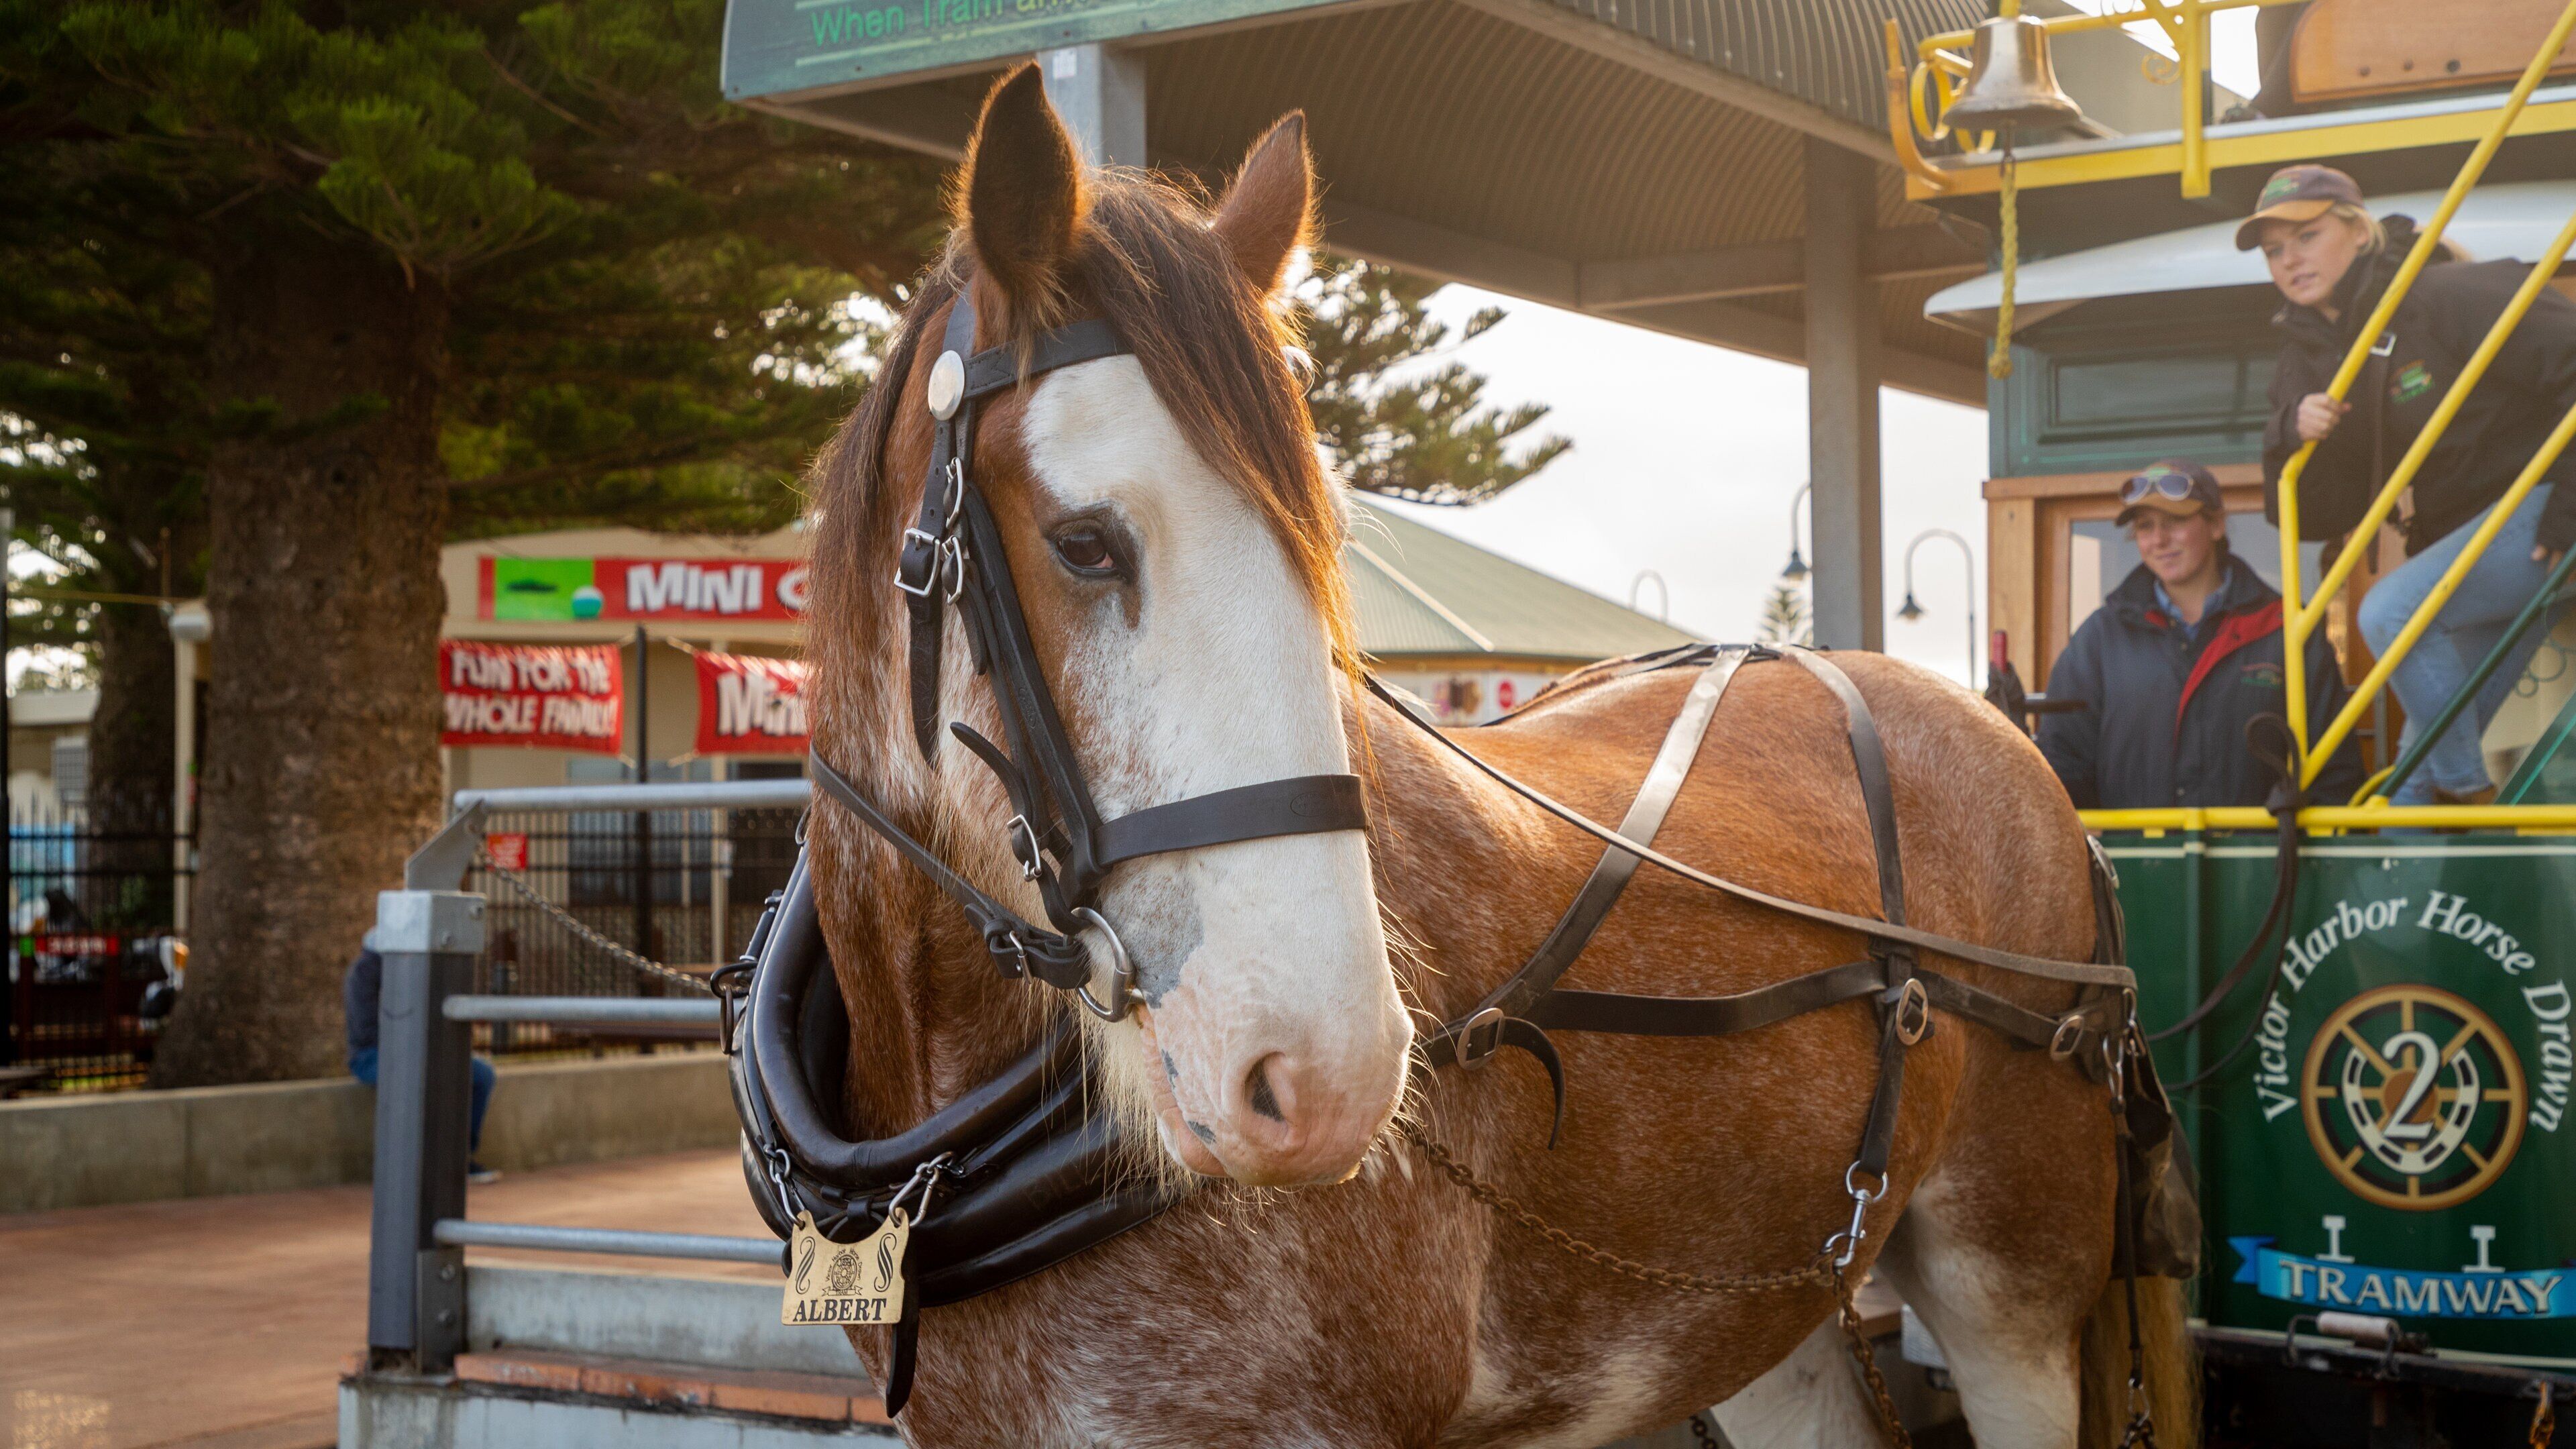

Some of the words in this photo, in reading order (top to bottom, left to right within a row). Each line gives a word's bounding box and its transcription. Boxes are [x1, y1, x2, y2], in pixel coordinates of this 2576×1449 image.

[810, 5, 904, 47] When
[627, 561, 764, 614] MINI
[451, 647, 514, 692] FUN
[443, 692, 536, 735] WHOLE
[2253, 990, 2298, 1123] Victor
[2281, 896, 2408, 993] Harbor
[2416, 889, 2536, 975] Horse
[2520, 979, 2573, 1132] Drawn
[2382, 1030, 2440, 1139] 2
[792, 1298, 887, 1322] ALBERT
[2279, 1258, 2563, 1315] TRAMWAY
